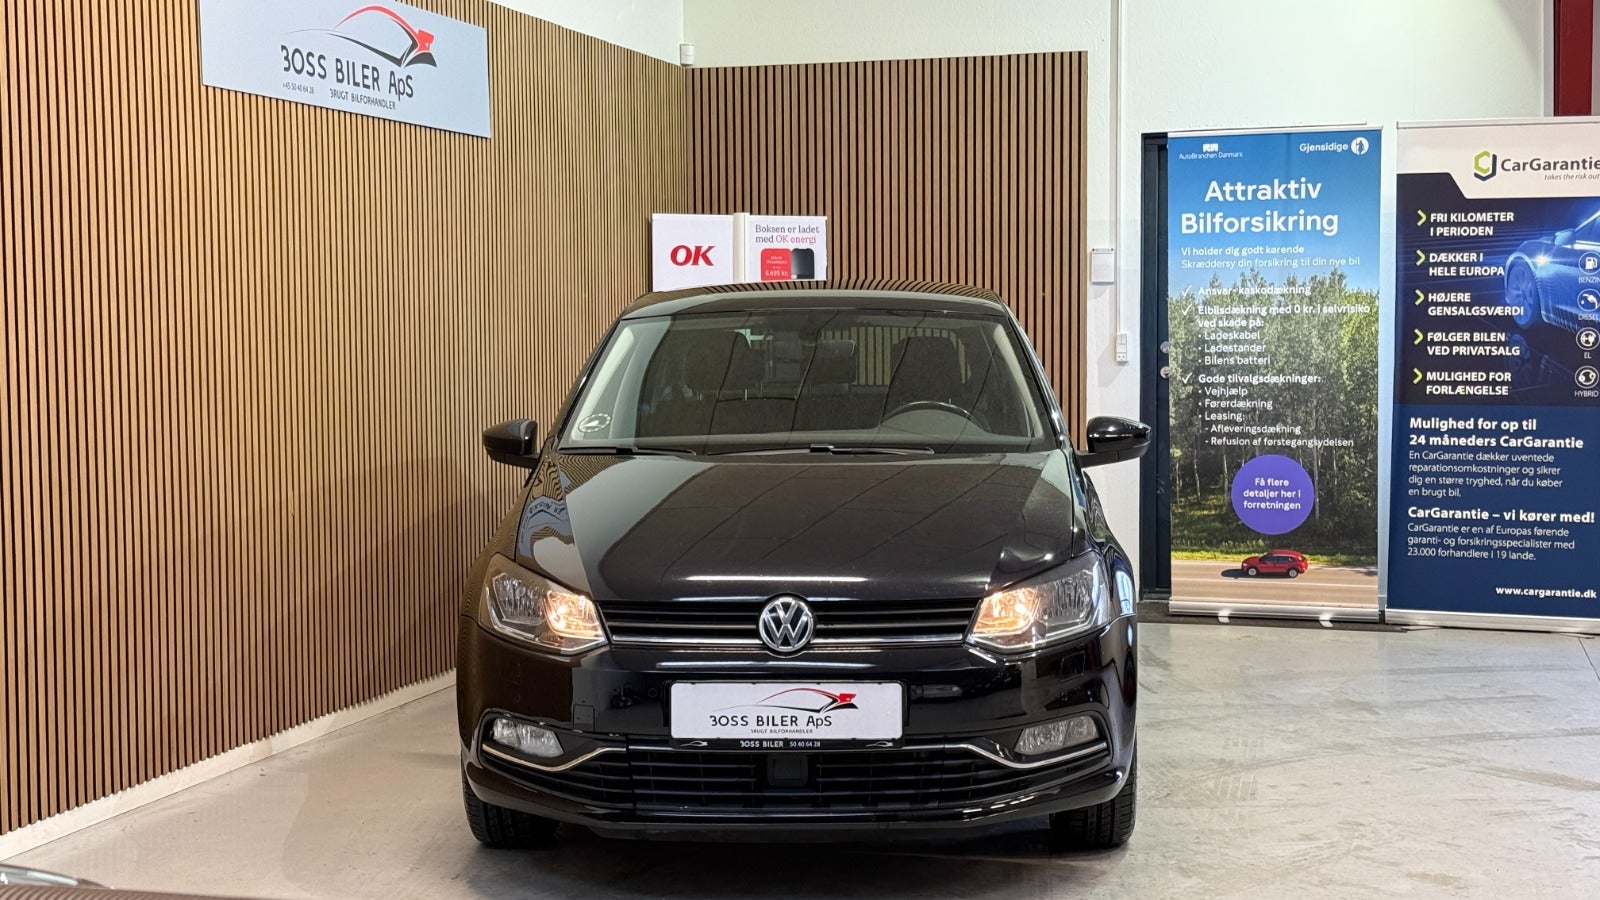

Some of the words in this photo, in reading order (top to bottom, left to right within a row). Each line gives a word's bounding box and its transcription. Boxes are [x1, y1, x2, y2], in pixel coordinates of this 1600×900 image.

[336, 58, 380, 91] BILER
[388, 71, 413, 101] ApS
[351, 93, 395, 110] BILFORHANDLER
[1300, 143, 1348, 153] Gjensidige
[1501, 157, 1600, 171] CarGarantie
[1205, 177, 1322, 201] Attraktiv
[1431, 213, 1447, 222] FRI
[1450, 212, 1514, 222] KILOMETER
[1181, 210, 1338, 236] Bilforsikring
[756, 224, 785, 233] Boksen
[799, 225, 819, 233] ladet
[1431, 227, 1433, 236] I
[1437, 227, 1493, 236] PERIODEN
[756, 235, 773, 243] med
[776, 235, 789, 243] OK
[791, 236, 816, 245] energi
[670, 245, 715, 266] OK
[1193, 247, 1222, 255] holder
[1225, 246, 1240, 256] dig
[1242, 246, 1264, 256] godt
[1266, 245, 1304, 254] kørende
[1429, 253, 1477, 262] DÆKKER
[1480, 253, 1483, 262] I
[1181, 259, 1235, 269] Skræddersy
[1238, 259, 1251, 267] din
[1255, 258, 1298, 268] forsikring
[1300, 258, 1310, 266] til
[1329, 258, 1346, 267] nye
[1348, 257, 1360, 265] bil
[1429, 267, 1457, 276] HELE
[1460, 267, 1504, 276] EUROPA
[1198, 286, 1236, 295] Ansvar-
[1239, 285, 1311, 295] kaskodækning
[1428, 293, 1471, 302] HØJERE
[1198, 306, 1266, 316] Elbilsdækning
[1269, 306, 1291, 314] med
[1294, 305, 1300, 313] 0
[1303, 305, 1316, 313] kr.
[1323, 305, 1370, 313] selvrisiko
[1428, 307, 1524, 316] GENSALGSVÆRDI
[1198, 320, 1216, 328] ved
[1218, 319, 1246, 327] skade
[1249, 319, 1264, 328] på:
[1204, 332, 1260, 340] Ladeskabel
[1428, 332, 1470, 342] FØLGER
[1473, 332, 1505, 342] BILEN
[1205, 344, 1266, 353] Ladestander
[1427, 346, 1449, 355] VED
[1453, 346, 1520, 355] PRIVATSALG
[1205, 357, 1235, 365] Bilens
[1237, 356, 1270, 365] batteri
[1199, 375, 1225, 383] Gode
[1228, 375, 1321, 384] tilvalgsdækninger:
[1426, 372, 1486, 382] MULIGHED
[1489, 372, 1511, 381] FOR
[1205, 387, 1248, 396] Vejhjælp
[1426, 386, 1508, 395] FORLÆNGELSE
[1205, 400, 1272, 409] Førerdækning
[1205, 412, 1245, 421] Leasing:
[1211, 425, 1301, 434] Afleveringsdækning
[1410, 418, 1474, 431] Mulighed
[1478, 418, 1497, 430] for
[1501, 421, 1518, 432] op
[1522, 419, 1536, 430] til
[1211, 437, 1250, 446] Refusion
[1253, 437, 1261, 445] af
[1264, 438, 1354, 448] førstegangsydelsen
[1410, 435, 1425, 445] 24
[1429, 435, 1496, 446] måneders
[1500, 436, 1584, 448] CarGarantie
[1409, 451, 1420, 459] En
[1422, 451, 1474, 460] CarGarantie
[1476, 452, 1508, 461] dækker
[1511, 454, 1554, 462] uventede
[1409, 464, 1519, 475] reparationsomkostninger
[1522, 467, 1534, 476] og
[1537, 466, 1560, 475] sikrer
[1255, 478, 1265, 486] Få
[1268, 478, 1289, 486] flere
[1409, 477, 1422, 485] dig
[1466, 477, 1503, 487] tryghed,
[1506, 478, 1520, 486] når
[1522, 478, 1534, 486] du
[1537, 479, 1563, 487] køber
[1243, 489, 1278, 499] detaljer
[1281, 490, 1296, 498] her
[1298, 489, 1301, 498] i
[1422, 488, 1446, 498] brugt
[1449, 489, 1461, 497] bil.
[1243, 501, 1300, 511] forretningen
[1408, 507, 1489, 519] CarGarantie
[1504, 510, 1515, 520] vi
[1520, 510, 1555, 522] kører
[1560, 512, 1594, 523] med!
[1408, 523, 1459, 532] CarGarantie
[1485, 525, 1494, 534] af
[1496, 526, 1531, 536] Europas
[1534, 527, 1569, 536] førende
[1408, 536, 1441, 545] garanti-
[1444, 538, 1455, 546] og
[1458, 537, 1552, 548] forsikringsspecialister
[1554, 540, 1575, 549] med
[1408, 548, 1436, 556] 23.000
[1438, 548, 1488, 558] forhandlere
[1497, 551, 1506, 559] 19
[1509, 551, 1536, 560] lande.
[1496, 587, 1596, 598] www.cargarantie.dk
[757, 716, 798, 726] BILER
[806, 716, 832, 729] ApS
